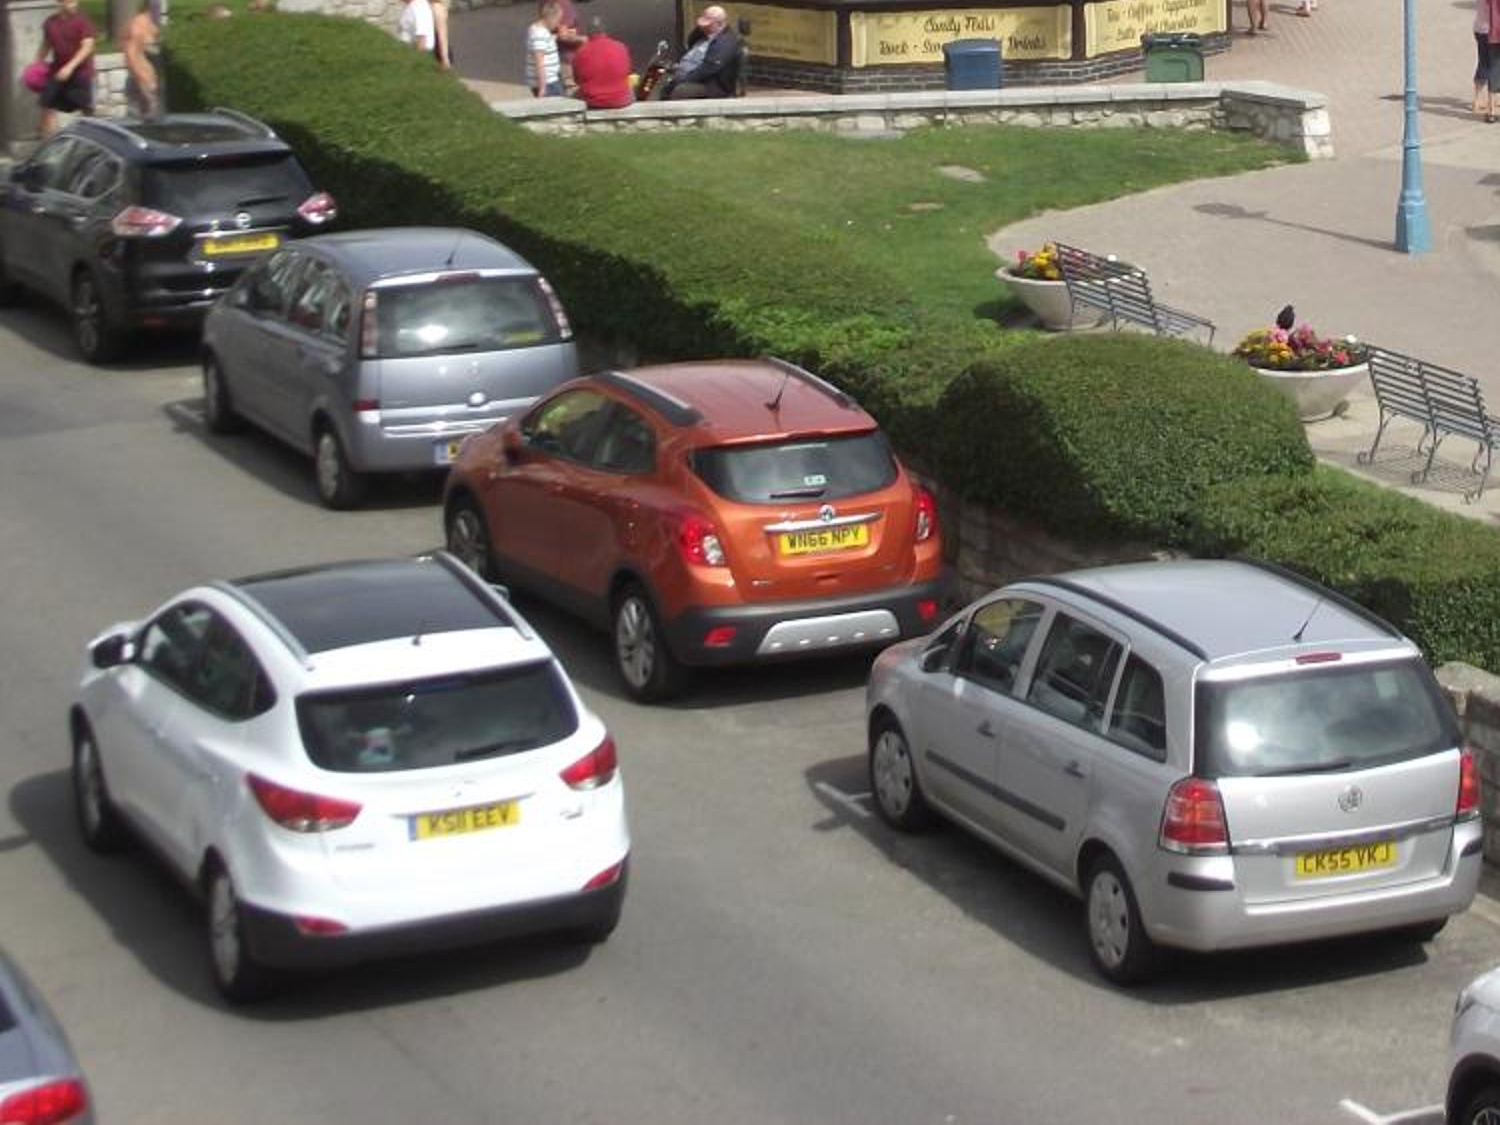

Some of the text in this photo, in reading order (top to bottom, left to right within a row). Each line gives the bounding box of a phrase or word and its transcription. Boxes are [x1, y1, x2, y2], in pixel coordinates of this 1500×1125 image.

[923, 18, 961, 35] Candy
[879, 40, 909, 55] Rock
[1303, 851, 1351, 874] CK55
